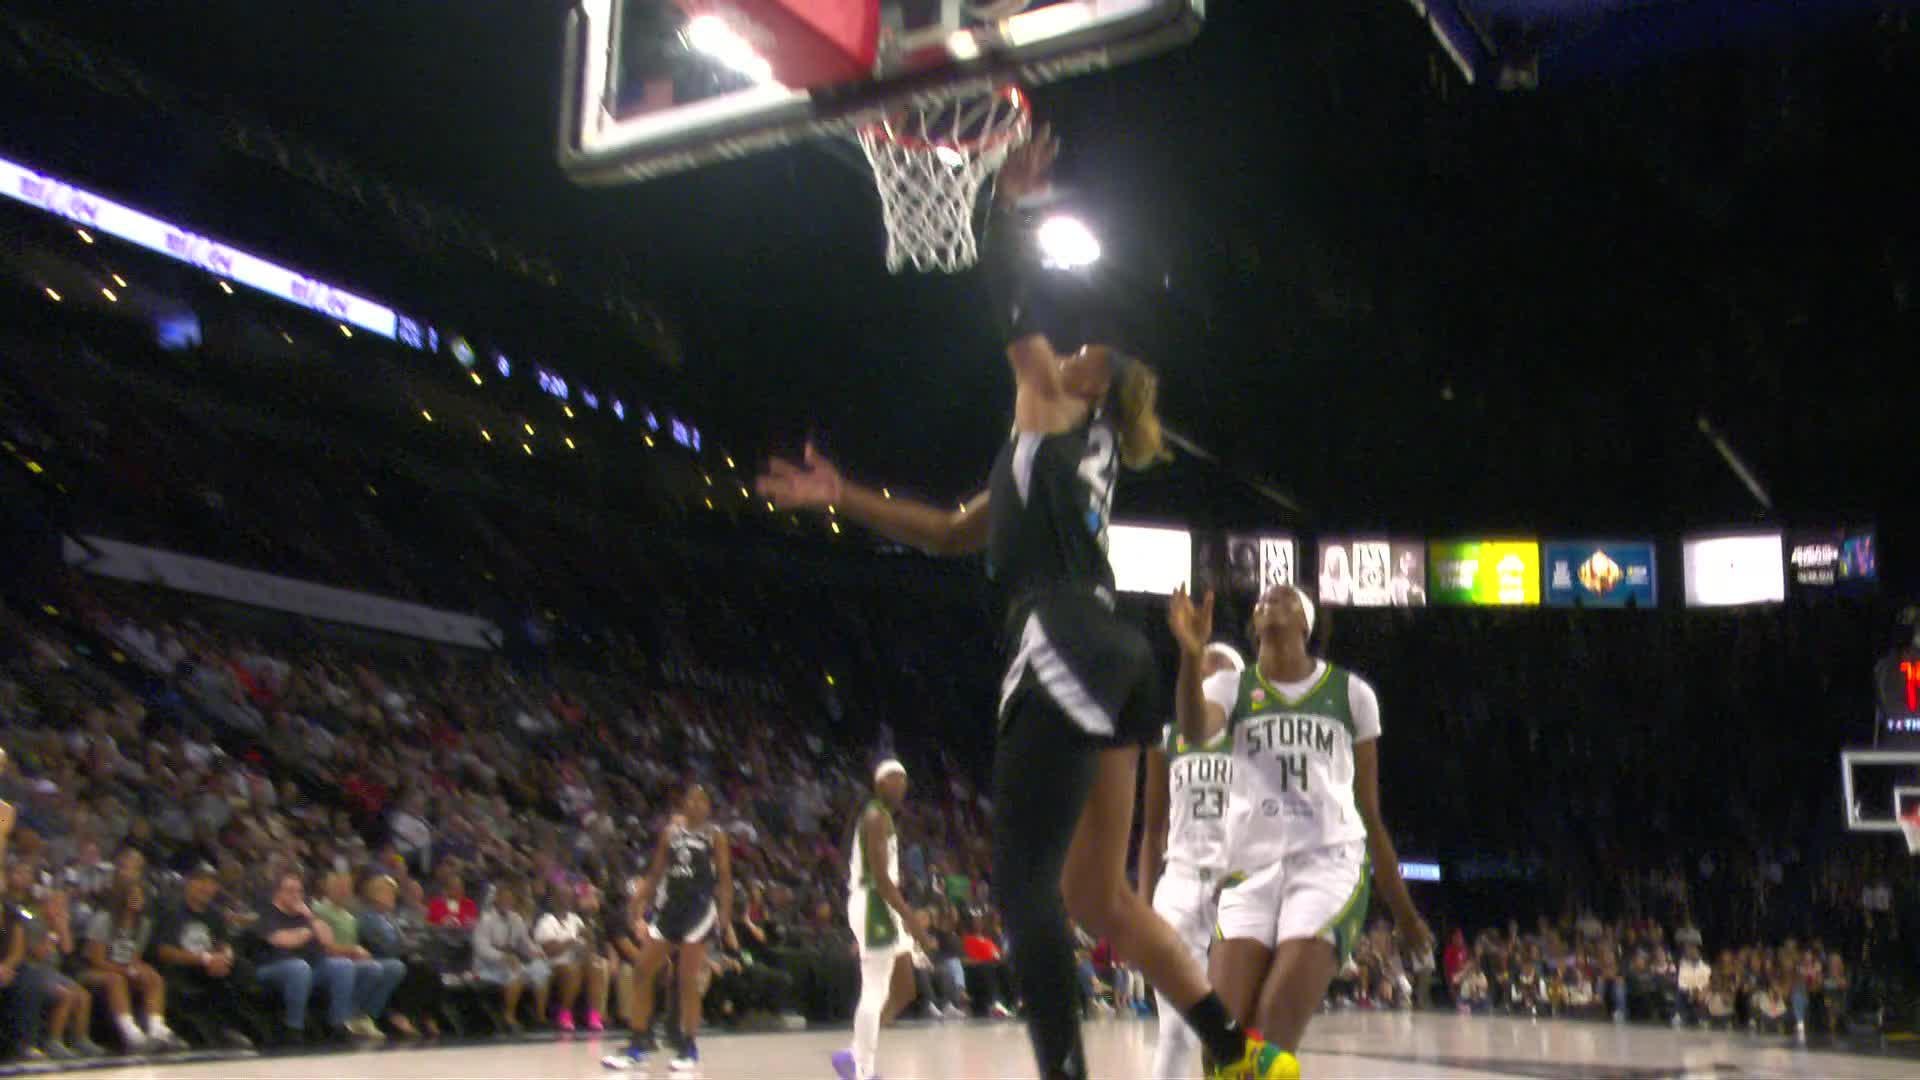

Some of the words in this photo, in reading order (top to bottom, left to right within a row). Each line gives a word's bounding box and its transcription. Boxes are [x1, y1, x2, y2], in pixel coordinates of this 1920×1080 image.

[1247, 716, 1334, 758] STORM
[1175, 758, 1232, 792] STOR
[1276, 752, 1308, 793] 14
[1191, 787, 1224, 819] 23
